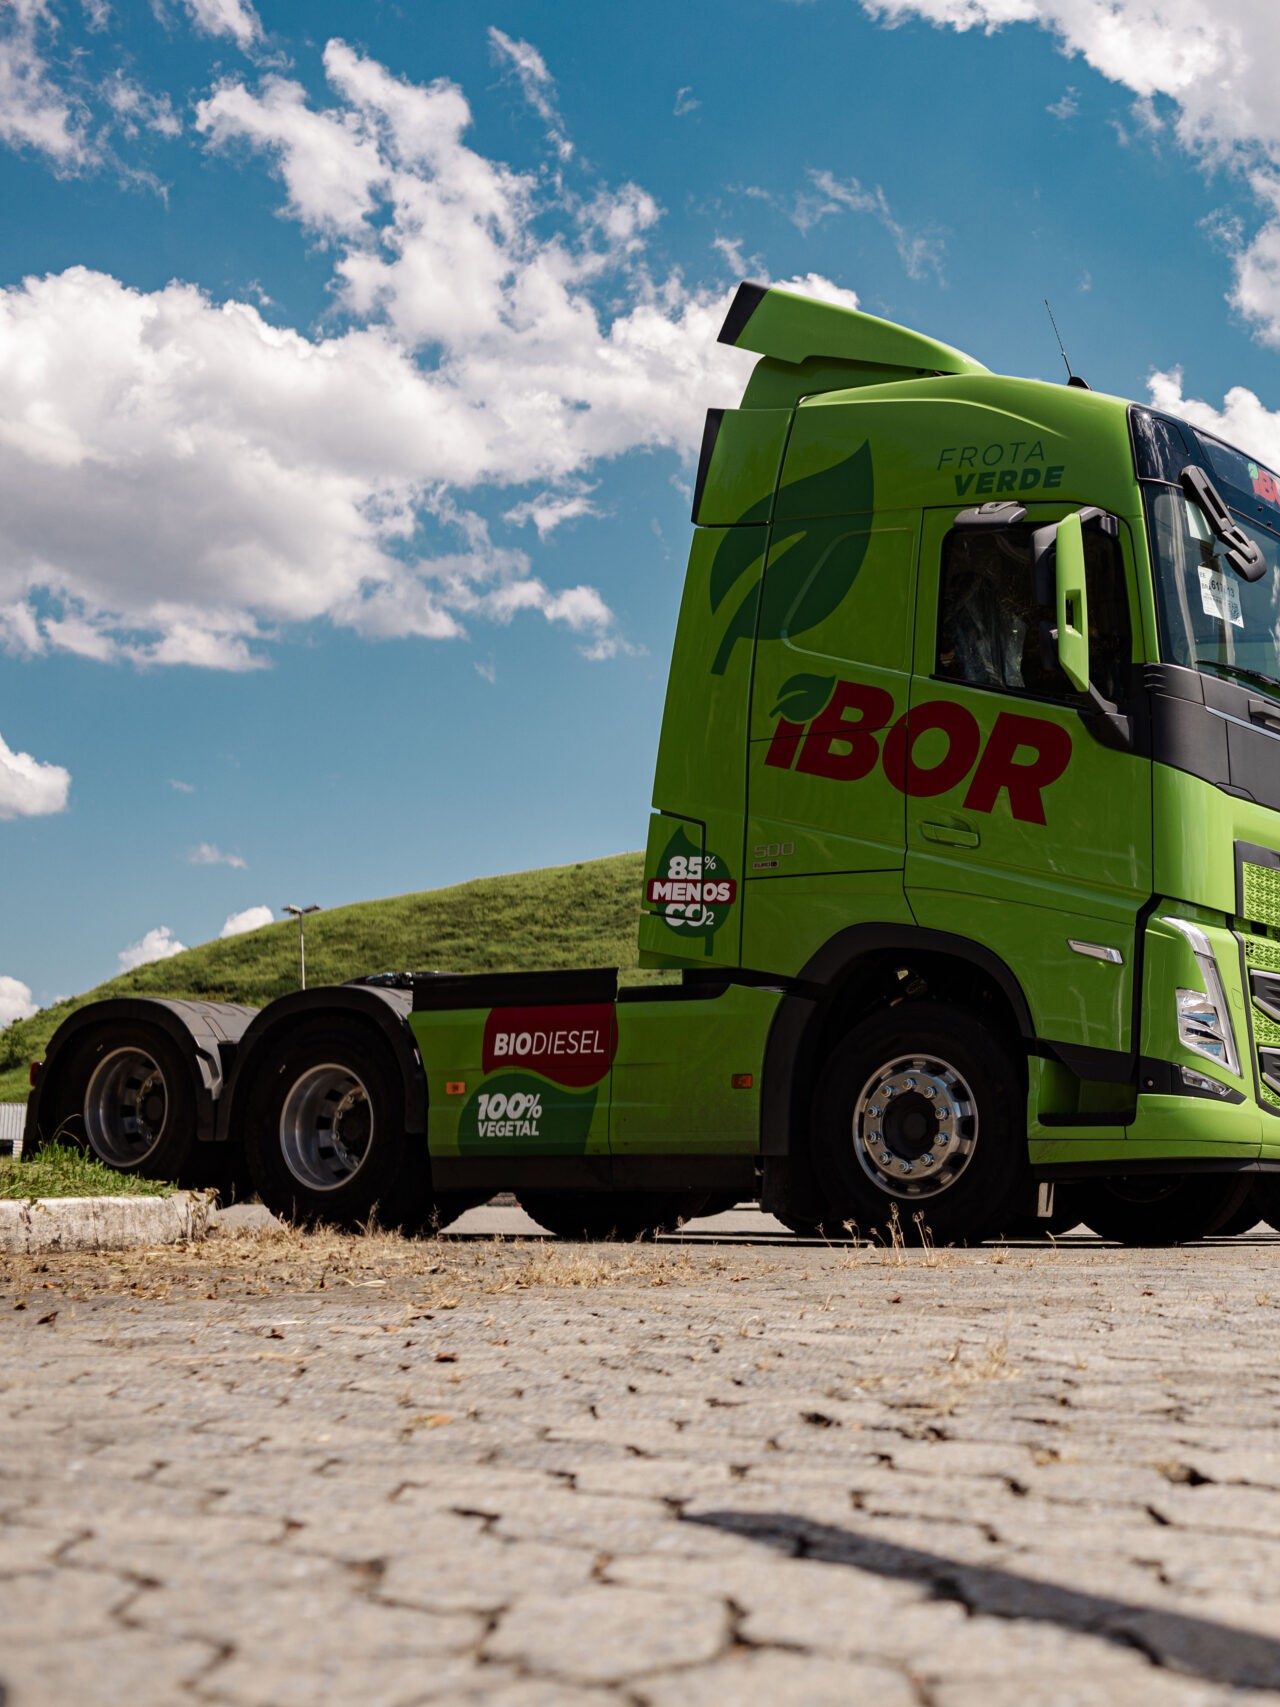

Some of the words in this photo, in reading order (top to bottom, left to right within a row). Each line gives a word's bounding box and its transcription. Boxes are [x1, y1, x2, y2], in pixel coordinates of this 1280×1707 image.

[937, 440, 1045, 471] FROTA
[954, 465, 1065, 497] VERDE
[754, 842, 795, 859] 500
[667, 855, 717, 880] 85%
[652, 881, 732, 902] MENOS
[493, 1030, 605, 1056] BIODIESEL
[477, 1092, 543, 1120] 100%
[477, 1120, 540, 1137] VEGETAL
